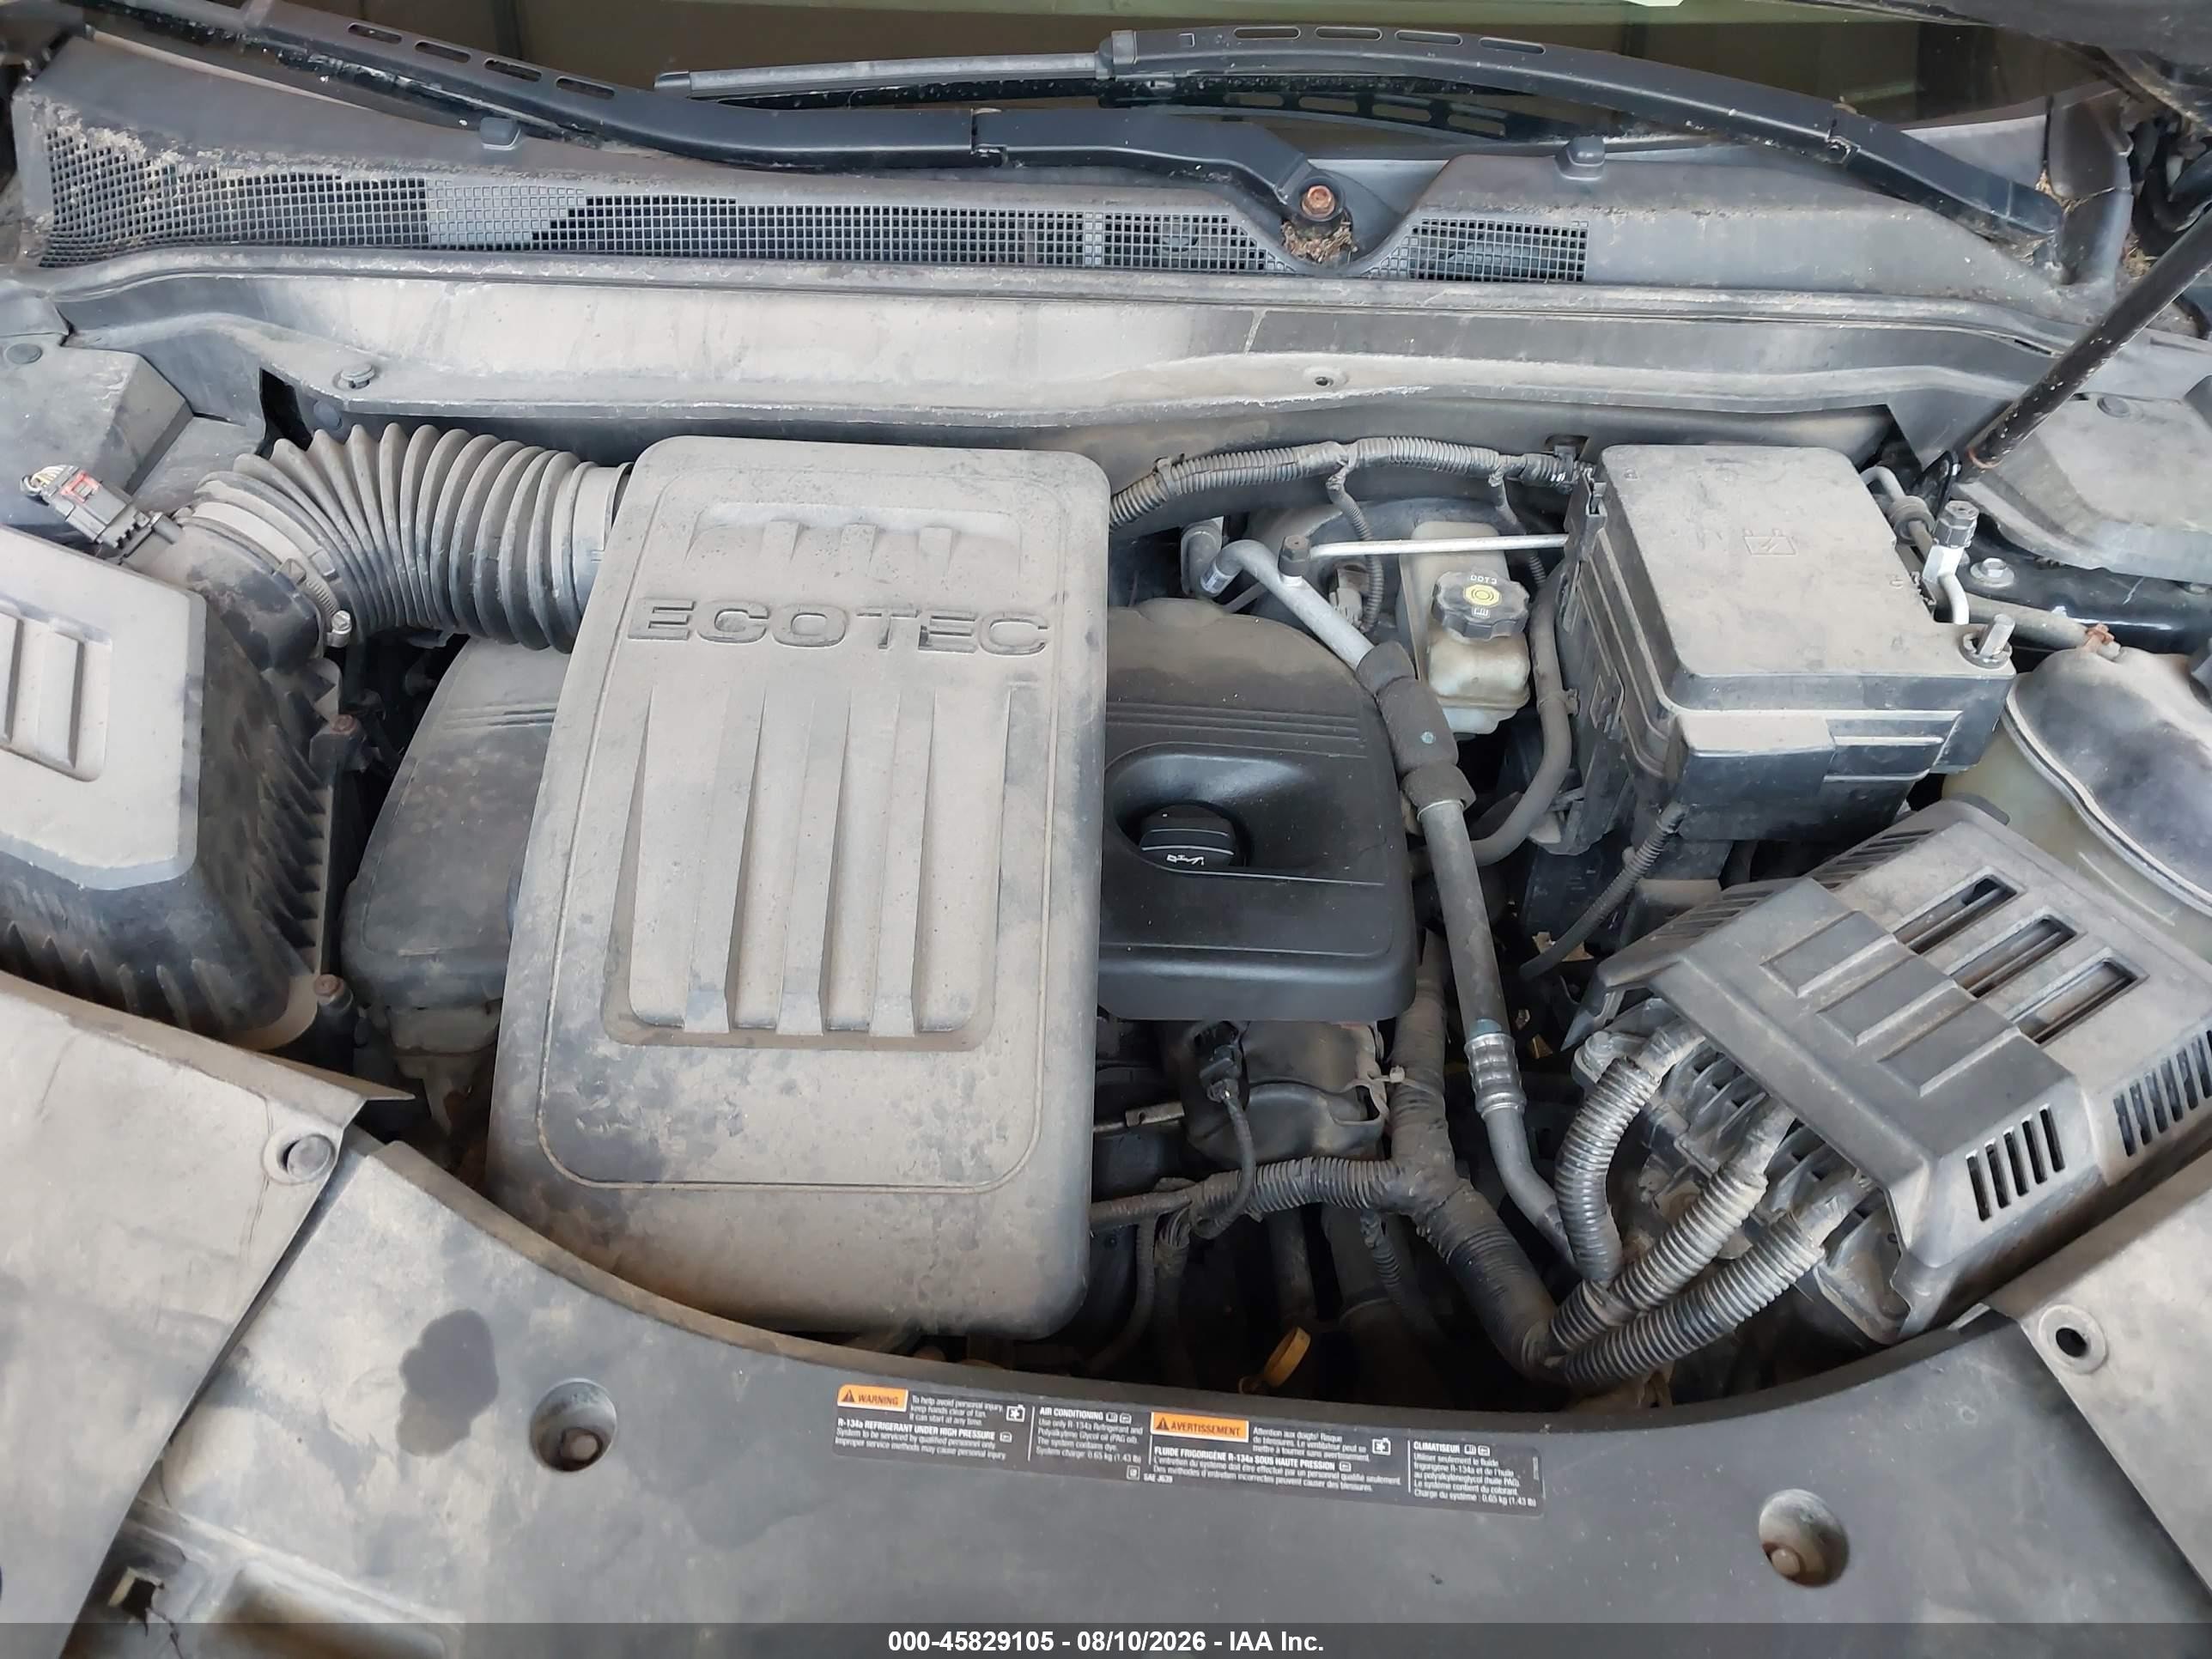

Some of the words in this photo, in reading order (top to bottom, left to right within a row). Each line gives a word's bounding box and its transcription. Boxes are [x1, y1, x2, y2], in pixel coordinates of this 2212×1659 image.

[628, 598, 1049, 657] ECOTEC
[859, 1395, 898, 1405] WARNING
[1040, 1407, 1052, 1416] AIR
[1054, 1408, 1103, 1420] CONDITIONING
[838, 1418, 863, 1428] R-134a
[865, 1420, 912, 1432] REFRIGERANT
[915, 1425, 938, 1435] UNDER
[940, 1427, 957, 1437] HIGH
[958, 1429, 994, 1440] PRESSURE
[1170, 1421, 1240, 1437] AVERTISSEMENT
[1413, 1441, 1460, 1453] CLIMATISEUR
[1155, 1446, 1178, 1457] FLUIDE
[1229, 1453, 1253, 1463] R-134a
[1255, 1455, 1273, 1465] SOUS
[1275, 1457, 1297, 1468] HAUTE
[1300, 1460, 1334, 1471] PRESSION
